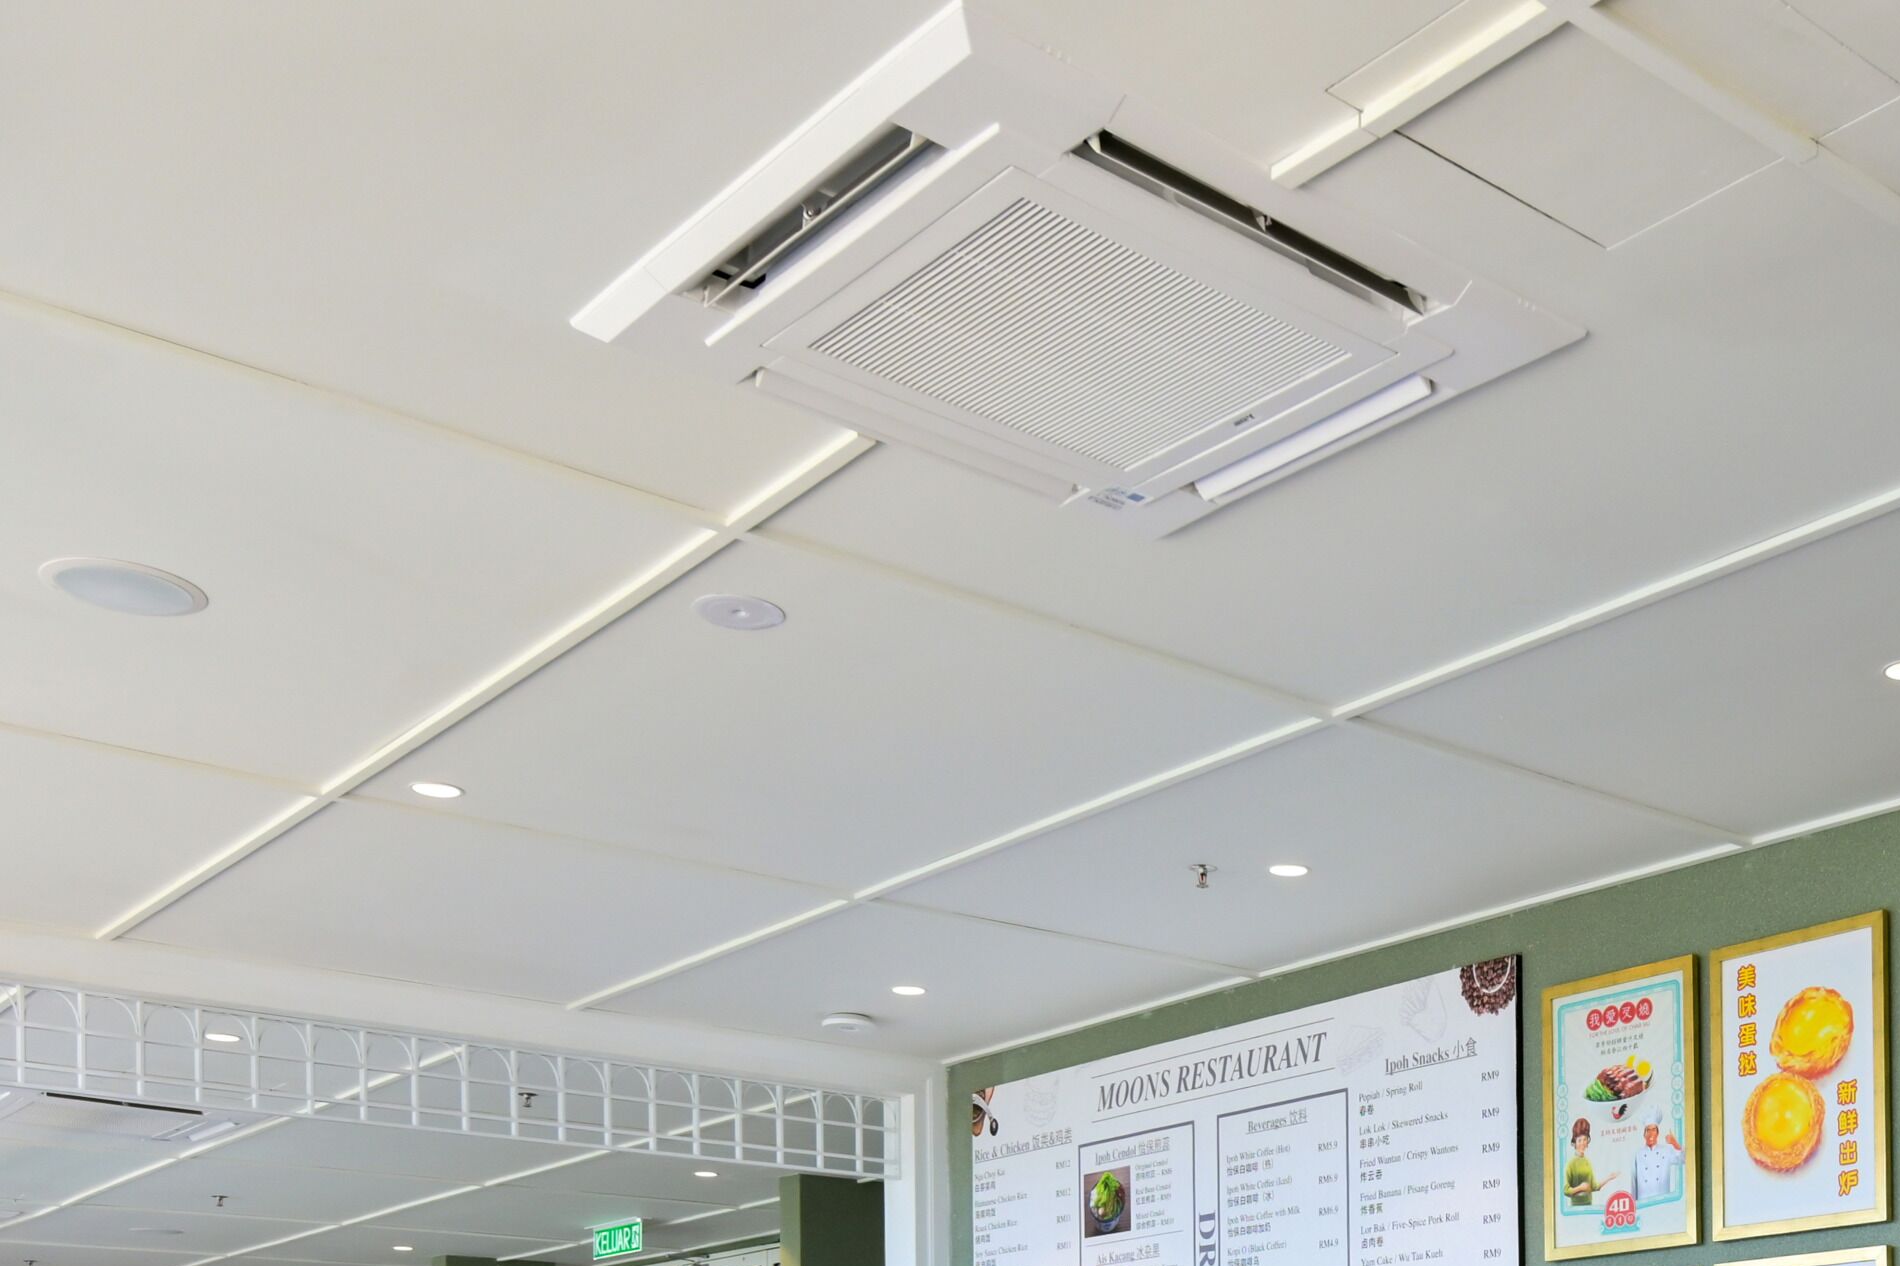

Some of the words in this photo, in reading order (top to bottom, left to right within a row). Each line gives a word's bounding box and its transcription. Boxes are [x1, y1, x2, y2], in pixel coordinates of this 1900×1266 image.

[1737, 964, 1757, 1077] 美味蛋挞
[1385, 1053, 1408, 1075] Ipoh
[1411, 1044, 1449, 1067] Snacks
[1452, 1035, 1477, 1060] 小食
[1097, 1069, 1171, 1112] MOONS
[1176, 1032, 1327, 1093] RESTAURANT
[1481, 1069, 1499, 1082] RM9
[1385, 1084, 1406, 1098] Spring
[1408, 1080, 1422, 1092] Roll
[1481, 1107, 1499, 1118] RM9
[1248, 1114, 1286, 1134] Beverages
[1359, 1125, 1371, 1135] Lok
[1373, 1122, 1385, 1132] Lok
[1391, 1114, 1422, 1129] Skewered
[1424, 1110, 1447, 1123] Snacks
[1837, 1079, 1858, 1196] 新鲜出炉
[974, 1147, 989, 1162] Rice
[992, 1146, 997, 1158] &
[1000, 1138, 1029, 1156] Chicken
[1482, 1142, 1500, 1153] RM9
[1359, 1157, 1375, 1168] Fried
[1407, 1148, 1428, 1162] Crispy
[1482, 1178, 1500, 1189] RM9
[1360, 1190, 1376, 1202] Fried
[1378, 1186, 1401, 1198] Banana
[1428, 1214, 1443, 1224] Pork
[1445, 1211, 1459, 1222] Roll
[1483, 1213, 1500, 1224] RM9
[594, 1228, 631, 1256] KELUAR
[1361, 1257, 1374, 1266] Yam
[1376, 1255, 1392, 1265] Cake
[1483, 1248, 1501, 1258] RM9
